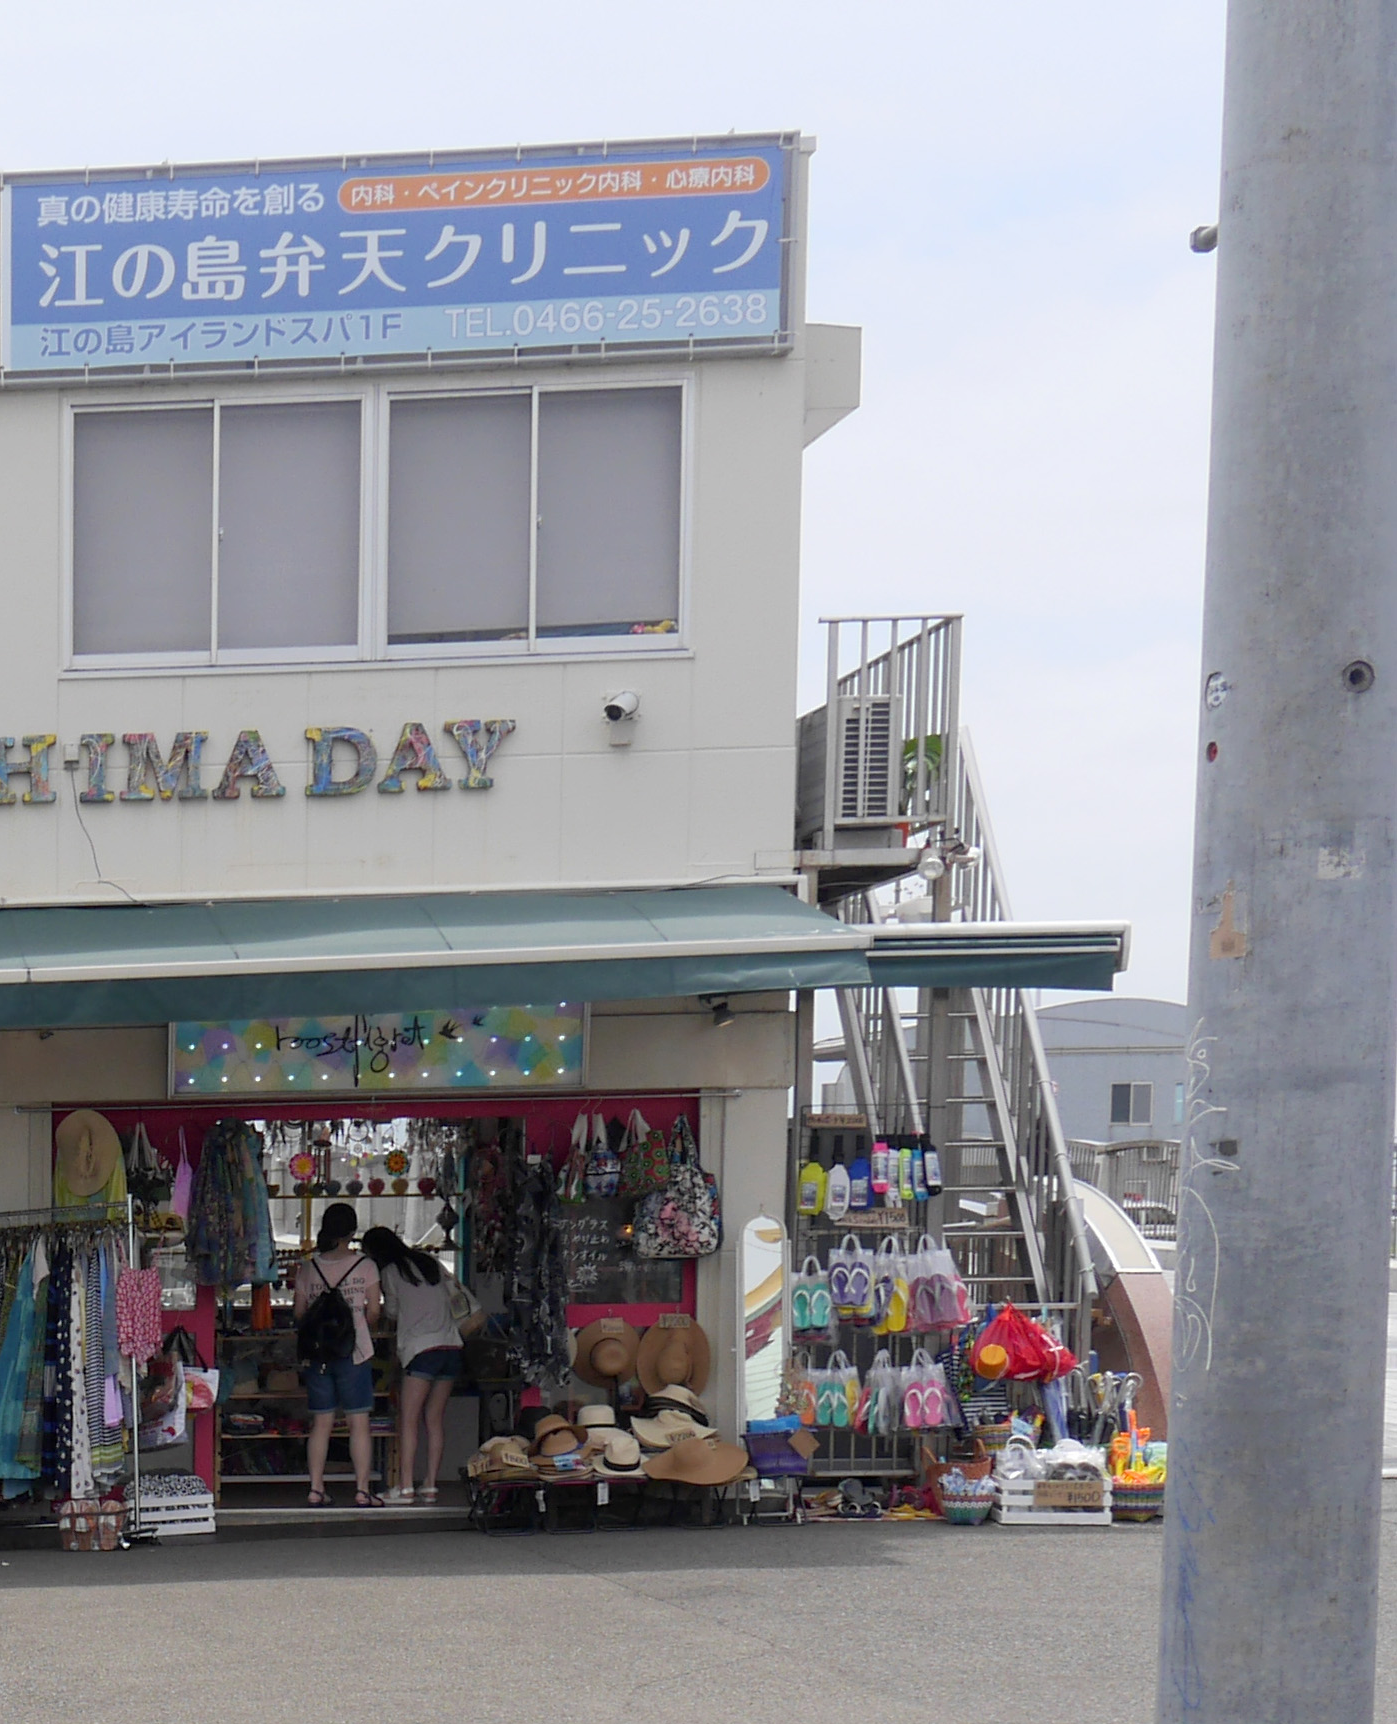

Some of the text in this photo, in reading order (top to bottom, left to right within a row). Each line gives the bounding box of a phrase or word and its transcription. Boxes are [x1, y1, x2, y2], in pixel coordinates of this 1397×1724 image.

[37, 182, 325, 227] 真の健康寿命を創る
[38, 209, 769, 308] 江の島弁天クリニック
[40, 313, 403, 357] 江の島アイランドスパ1F
[444, 293, 768, 339] TEL.0466-25-2638
[304, 718, 516, 797] DAY
